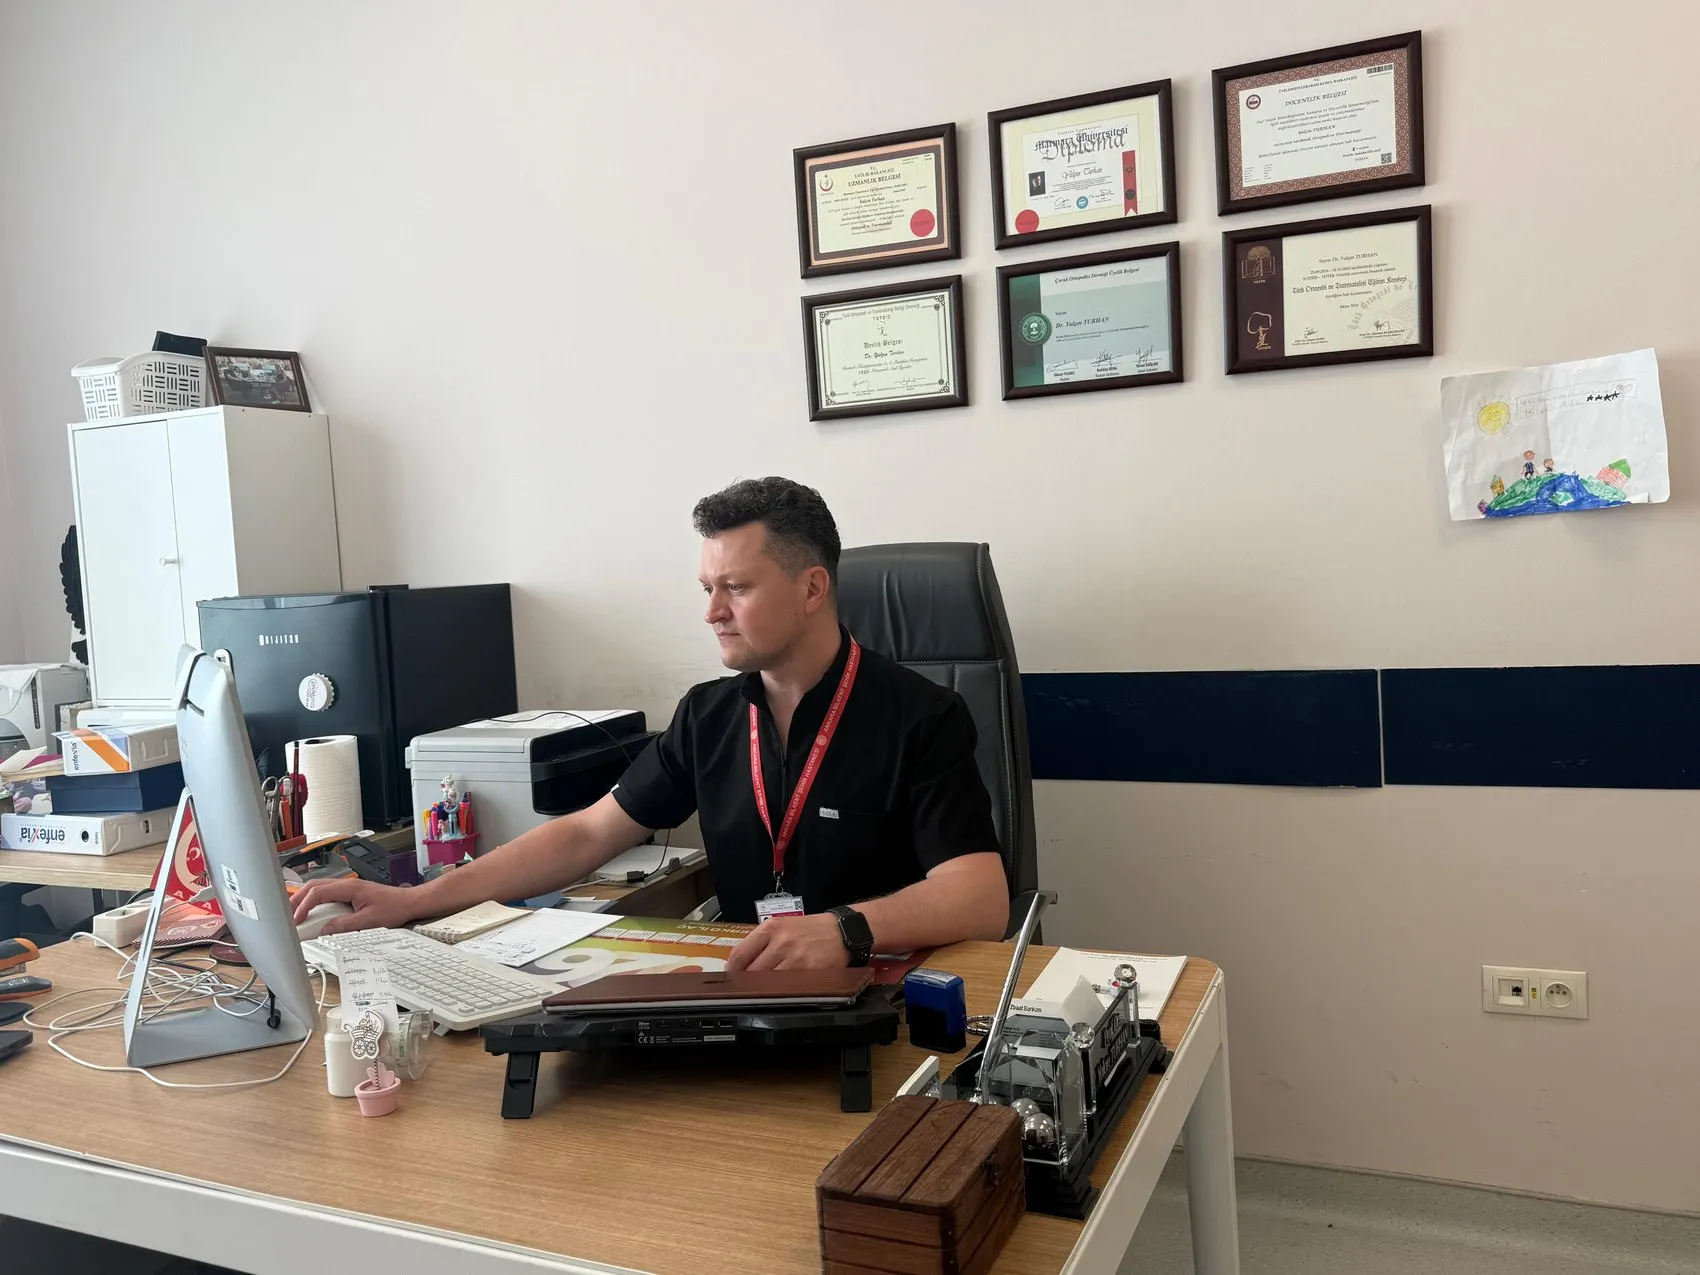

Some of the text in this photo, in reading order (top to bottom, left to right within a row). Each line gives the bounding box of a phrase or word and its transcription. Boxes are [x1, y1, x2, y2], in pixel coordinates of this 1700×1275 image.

[1039, 134, 1126, 164] Diploma
[848, 172, 902, 187] UZMANLIK BELGESİ
[1084, 316, 1110, 325] TURHAN
[824, 710, 836, 732] ANKARA
[832, 688, 845, 710] BİLKENT
[71, 742, 79, 770] enfexia
[782, 747, 820, 837] ANKARA BİLKENT ŞEHİR HASTANESİ
[20, 827, 66, 844] enfexia
